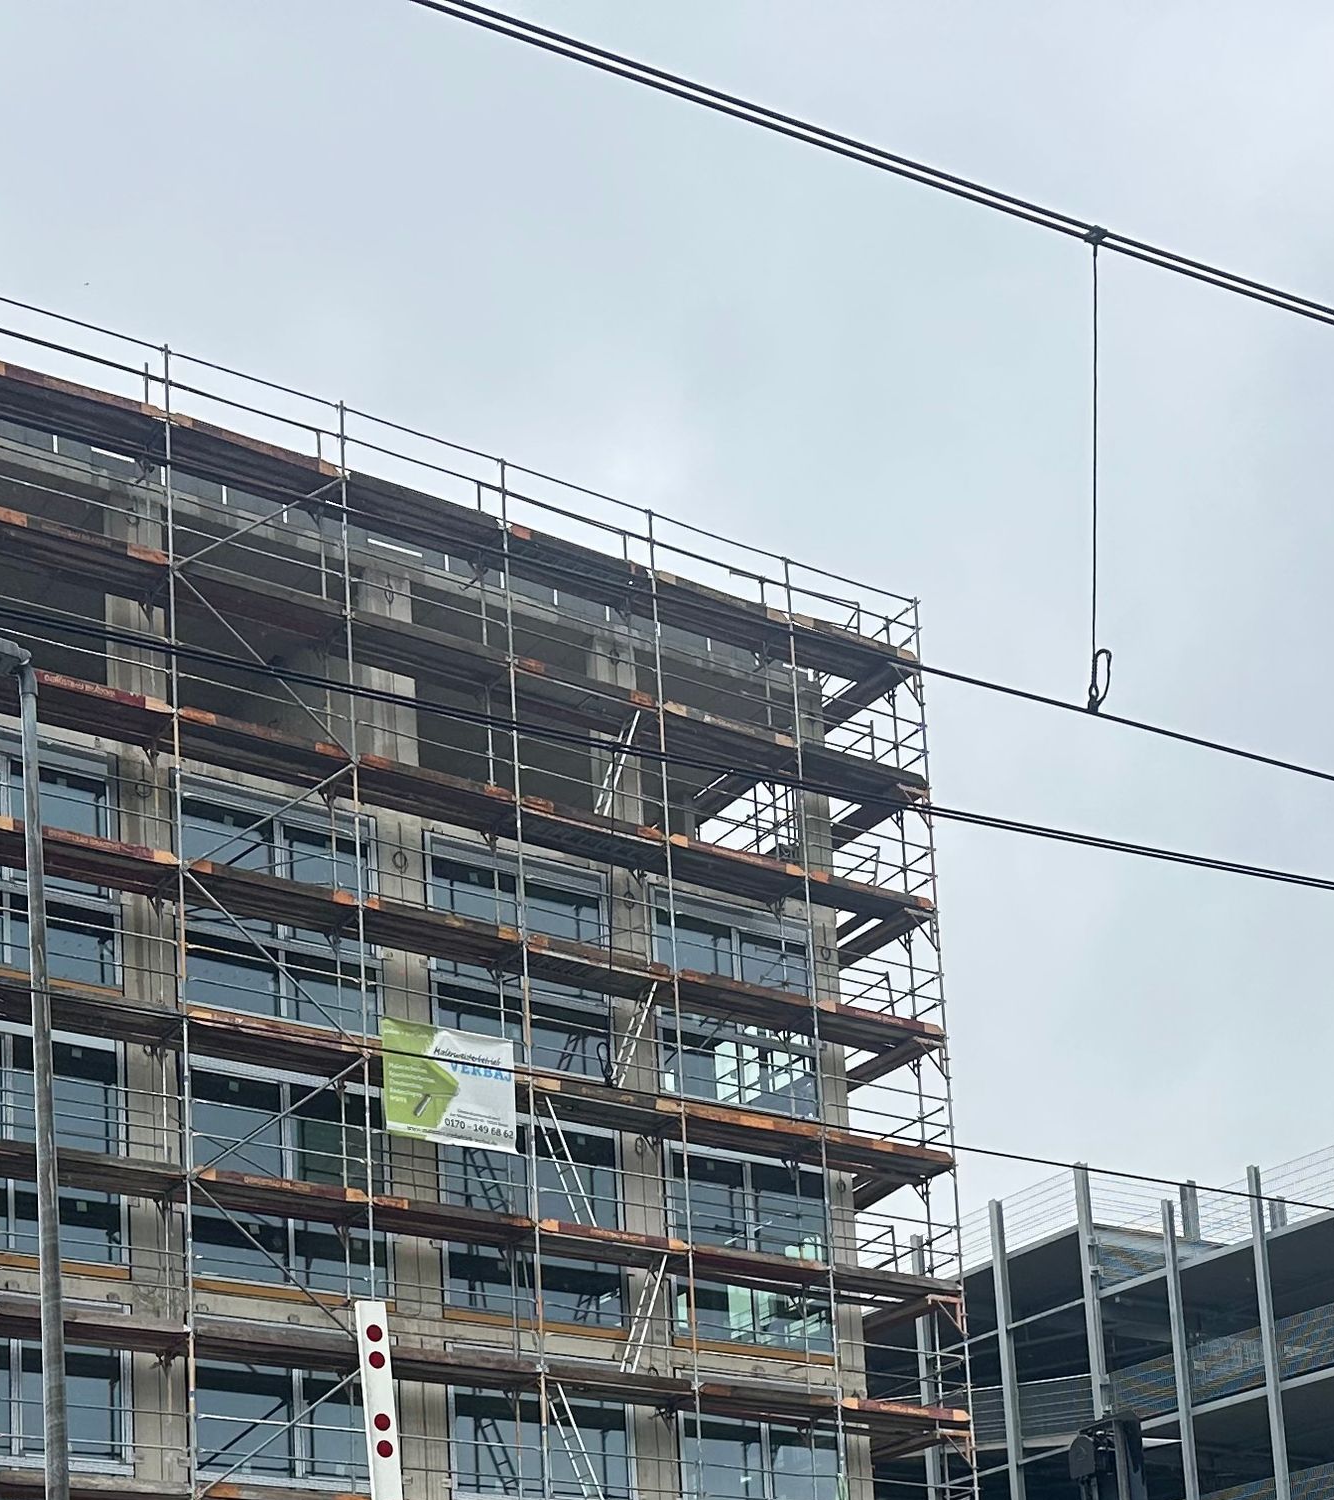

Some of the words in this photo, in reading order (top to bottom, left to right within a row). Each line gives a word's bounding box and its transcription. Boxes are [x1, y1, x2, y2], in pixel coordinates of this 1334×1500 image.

[444, 1117, 466, 1131] 0170
[473, 1124, 489, 1134] 149
[503, 1128, 514, 1140] 62
